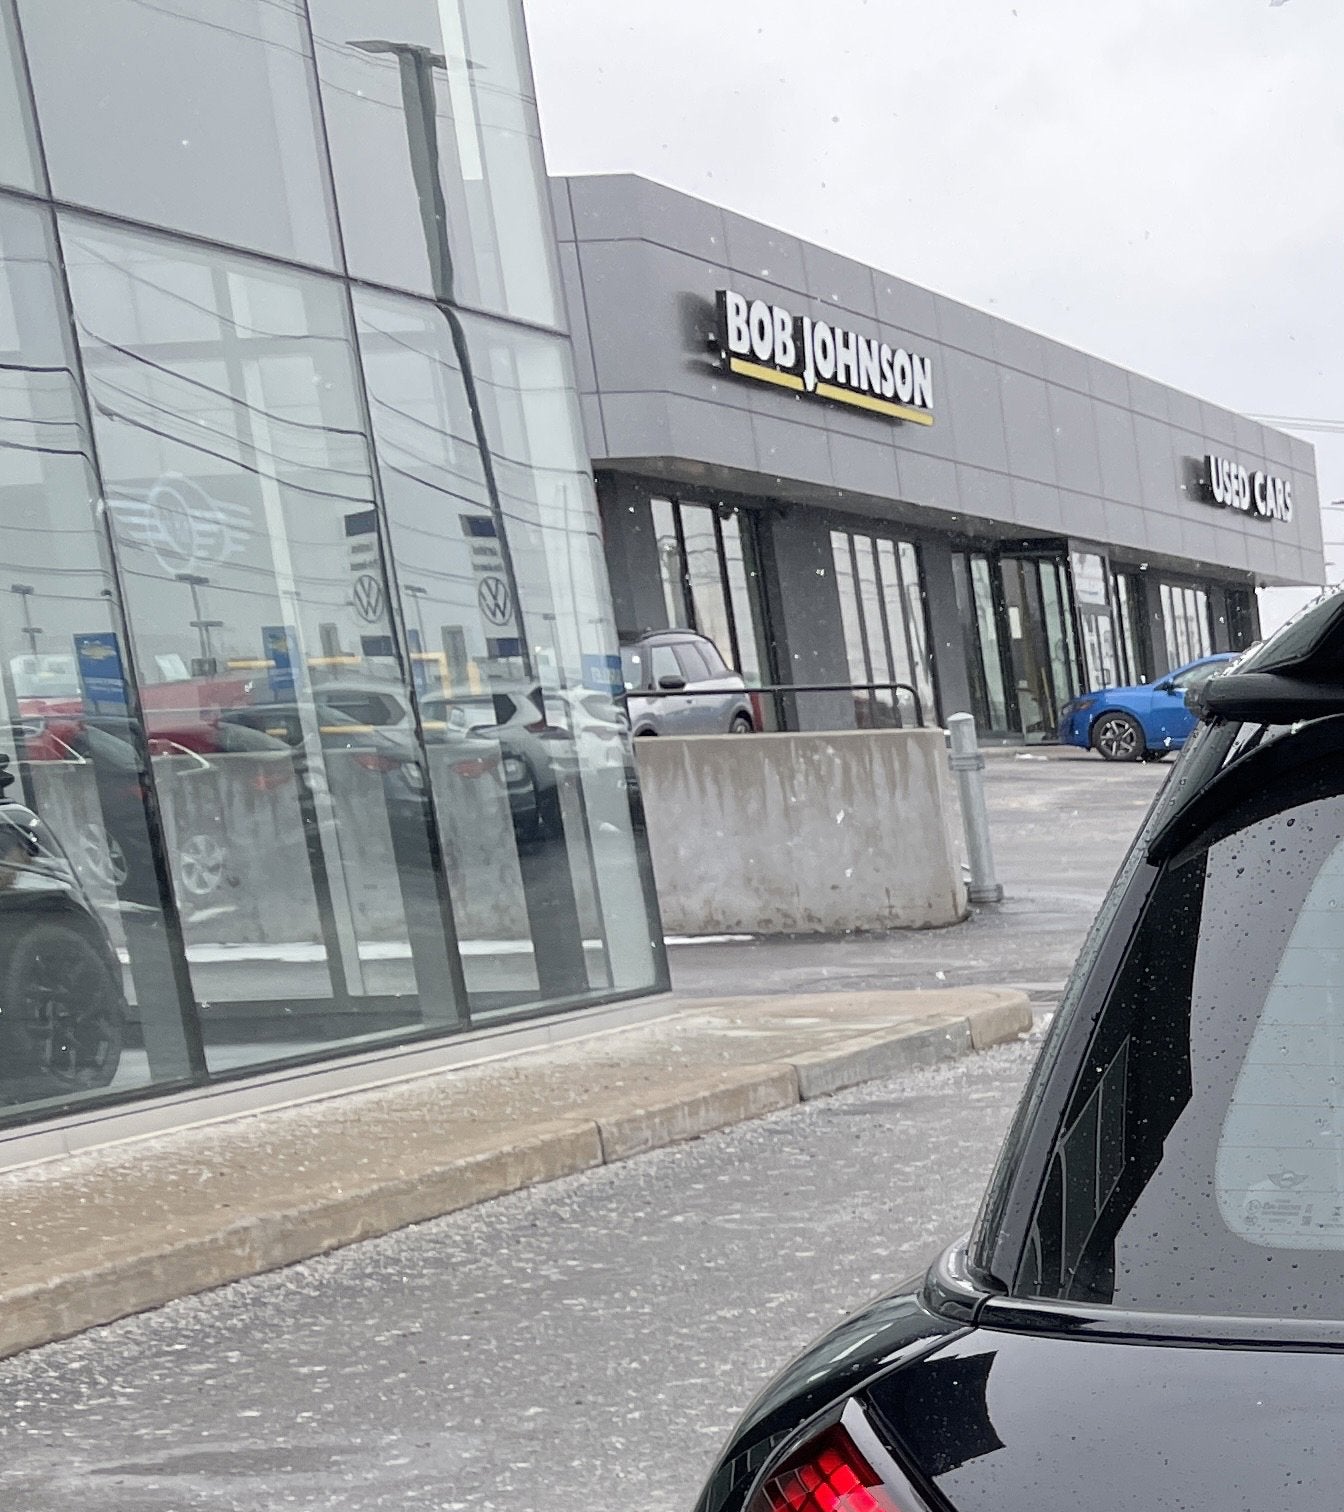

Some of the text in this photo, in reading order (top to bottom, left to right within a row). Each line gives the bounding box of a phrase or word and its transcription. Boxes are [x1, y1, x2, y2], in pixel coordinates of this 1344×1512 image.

[725, 290, 934, 409] BOB JOHNSON
[1209, 454, 1293, 523] USED CARS
